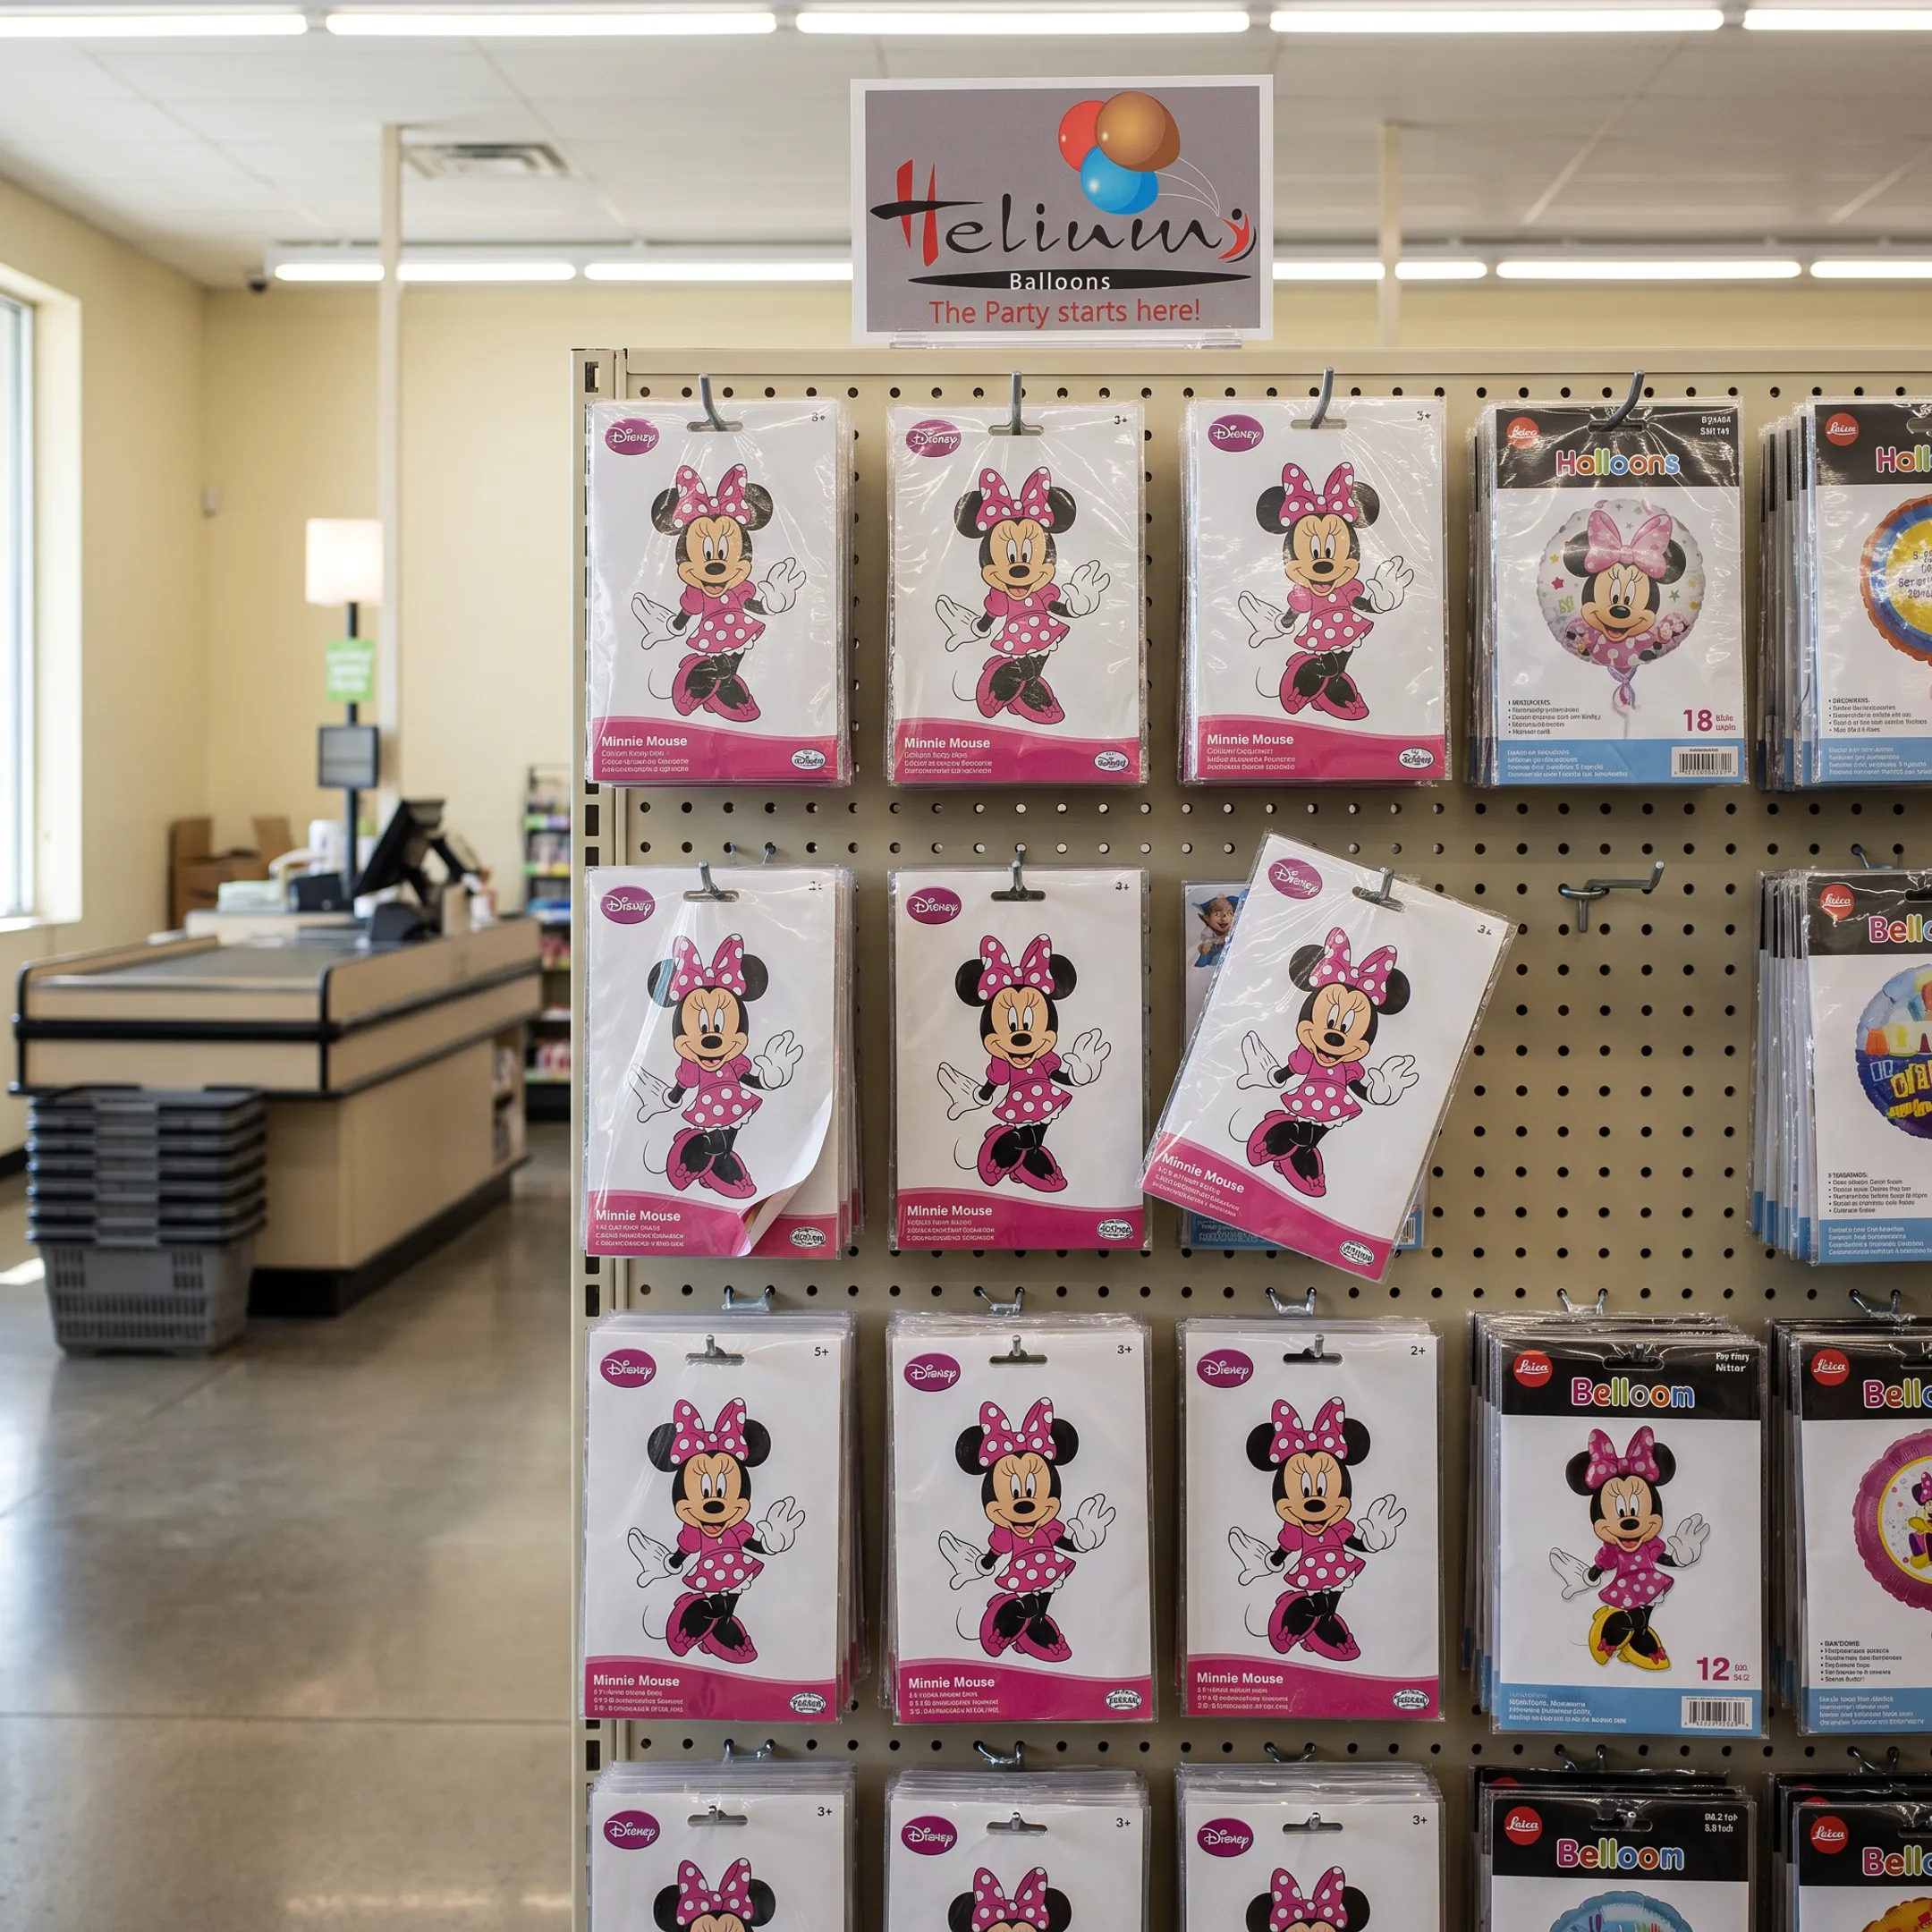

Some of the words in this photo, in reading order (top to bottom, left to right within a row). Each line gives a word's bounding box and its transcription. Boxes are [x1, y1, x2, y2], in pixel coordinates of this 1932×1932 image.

[1009, 273, 1111, 291] Balloons
[928, 300, 976, 323] The
[986, 301, 1049, 329] Party
[1058, 300, 1127, 322] starts
[1137, 298, 1200, 321] here!
[1876, 445, 1932, 473] Hall
[1683, 709, 1713, 732] 18
[602, 736, 643, 747] Minnie
[647, 736, 689, 748] Mouse
[904, 738, 945, 748] Minnie
[949, 738, 991, 748] Mouse
[1207, 734, 1249, 744] Minnie
[1252, 734, 1294, 744] Mouse
[1161, 1152, 1201, 1178] Minnie
[1203, 1168, 1245, 1194] Mouse
[596, 1210, 637, 1221] Minnie
[640, 1210, 682, 1222] Mouse
[952, 1205, 993, 1216] Mouse
[814, 1346, 829, 1356] 5+
[1116, 1344, 1133, 1355] 3+
[1411, 1346, 1426, 1356] 2+
[1572, 1377, 1696, 1409] Belloom
[1697, 1657, 1730, 1681] 12
[594, 1675, 636, 1686] Minnie
[640, 1675, 681, 1687] Mouse
[909, 1678, 950, 1689] Minnie
[953, 1677, 996, 1689] Mouse
[1197, 1673, 1238, 1683] Minnie
[1241, 1673, 1284, 1684] Mouse
[818, 1807, 833, 1817] 3+
[1115, 1818, 1131, 1828] 3+
[1412, 1815, 1428, 1826] 3+
